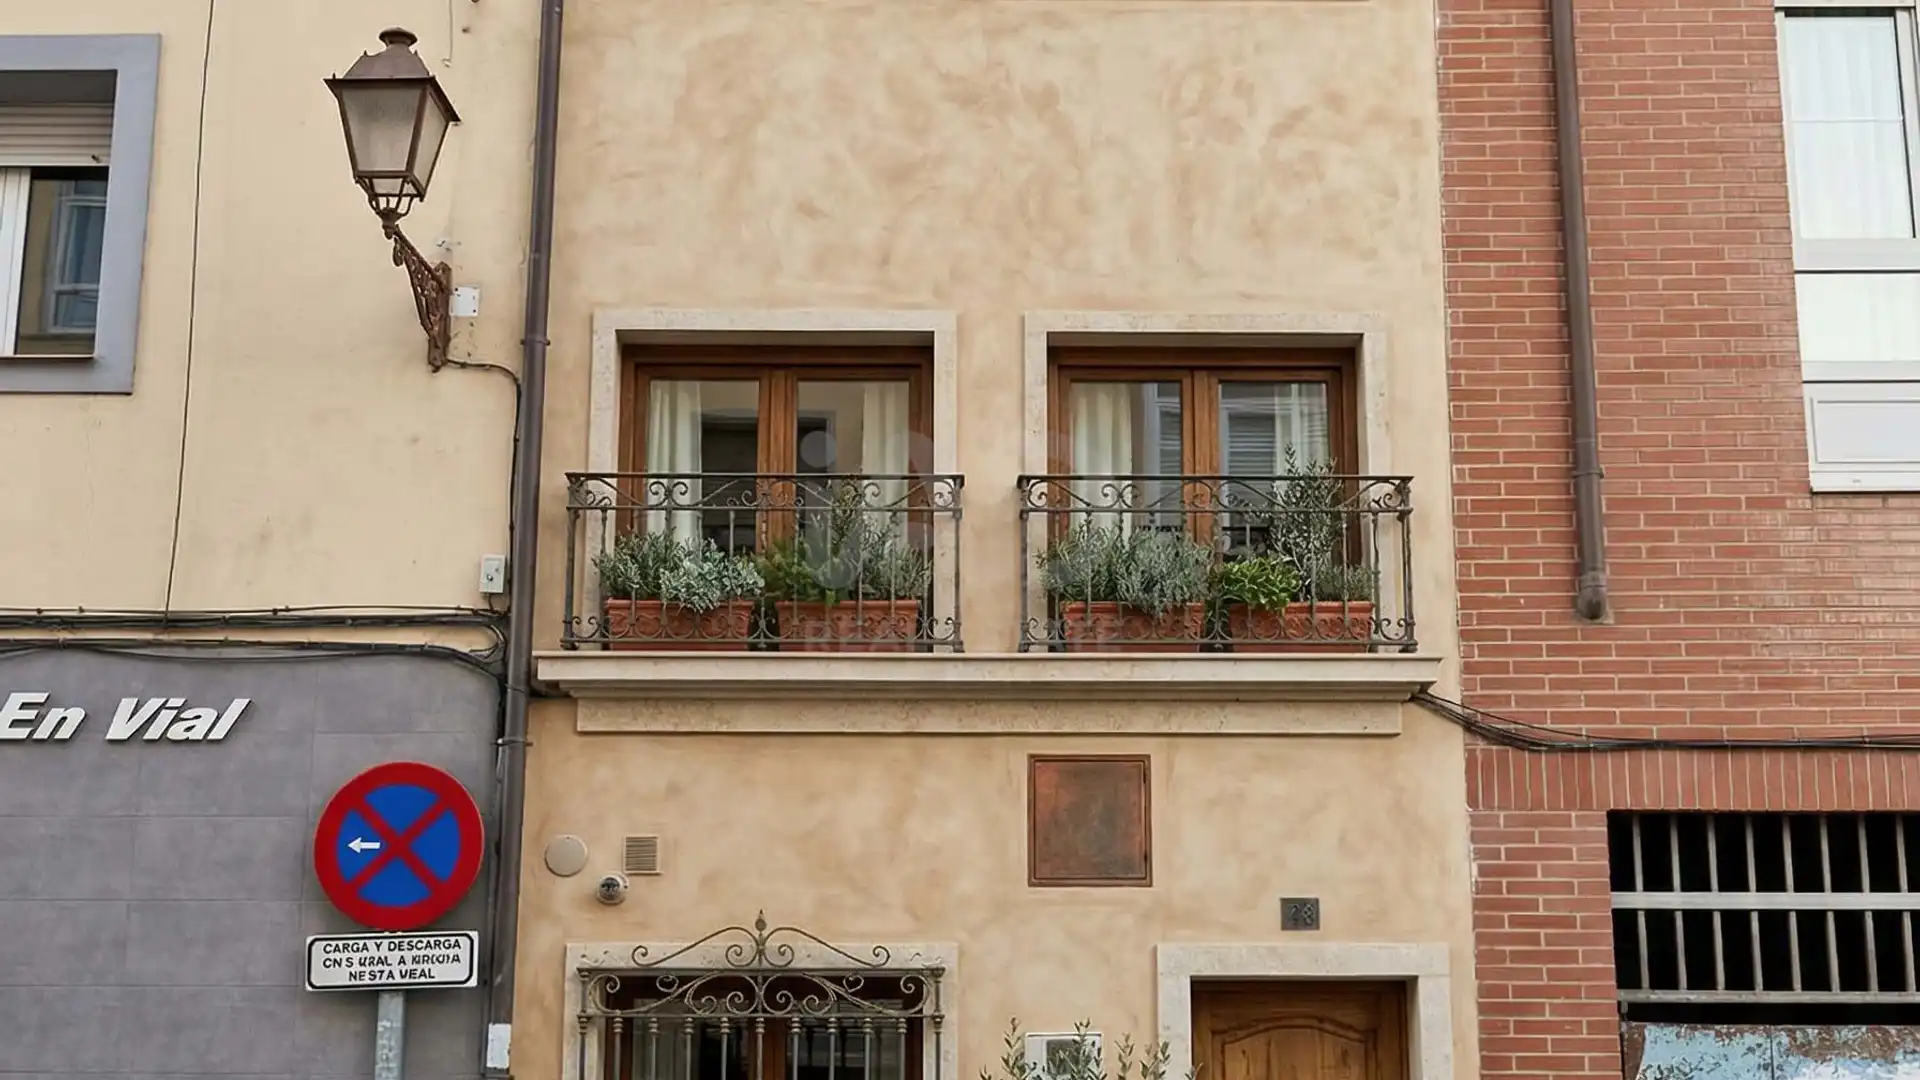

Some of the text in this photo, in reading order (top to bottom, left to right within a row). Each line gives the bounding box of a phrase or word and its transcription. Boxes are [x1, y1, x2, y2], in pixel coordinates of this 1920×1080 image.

[0, 692, 251, 741] En Vial
[322, 939, 462, 954] CARGA Y DESCARGA
